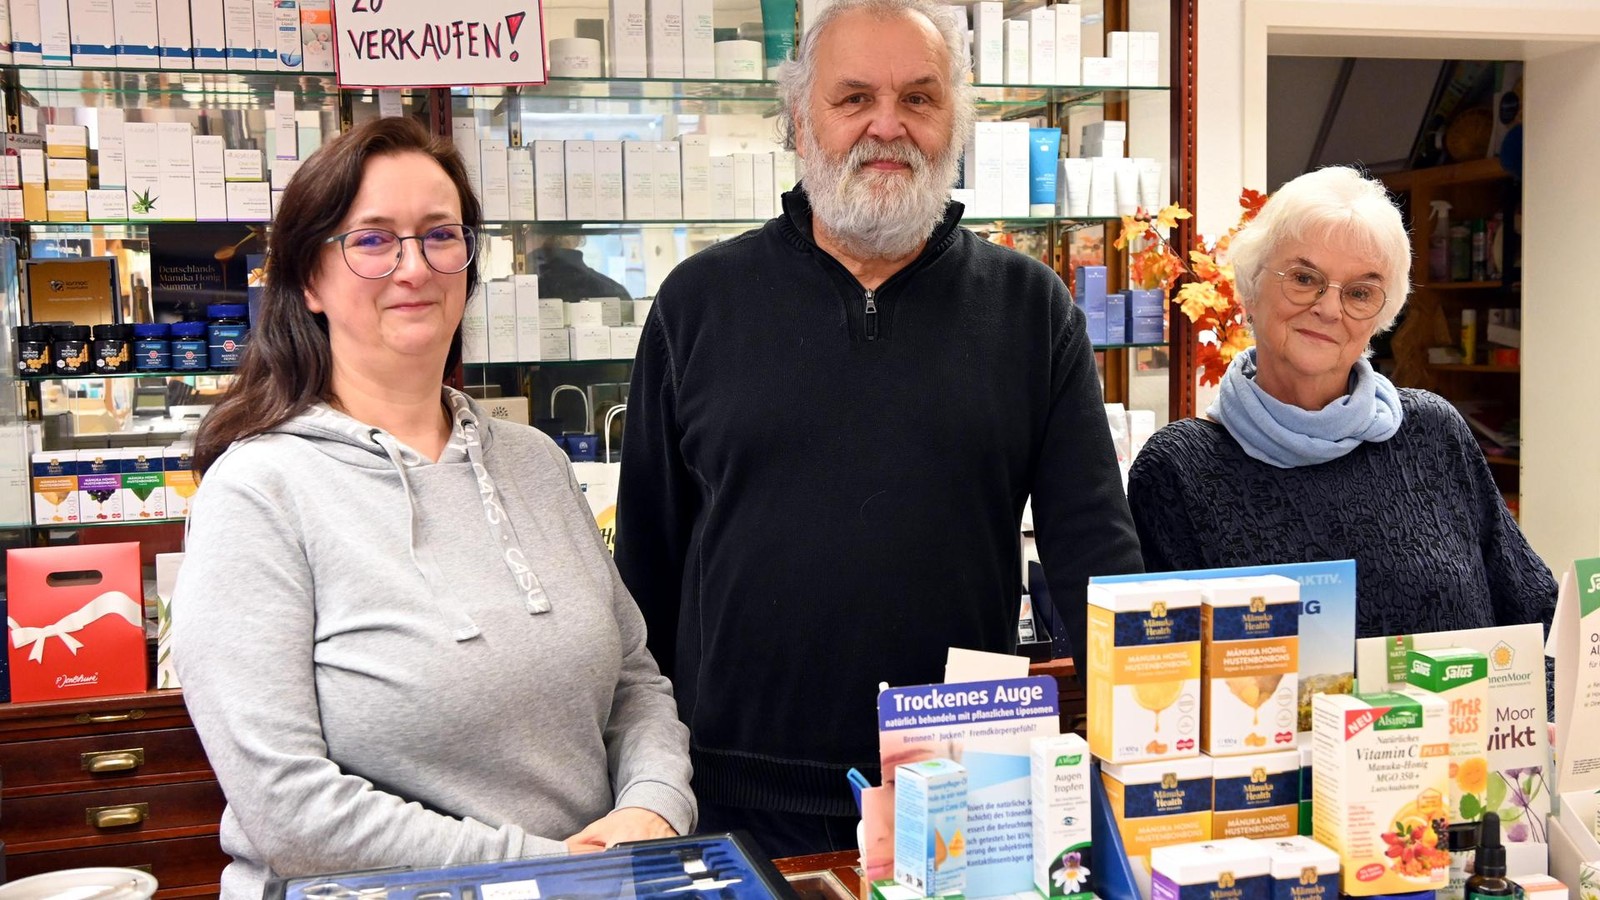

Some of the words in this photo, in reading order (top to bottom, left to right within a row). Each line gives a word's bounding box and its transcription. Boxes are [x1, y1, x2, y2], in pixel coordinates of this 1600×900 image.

[347, 11, 526, 62] VERKAUFEN!
[159, 265, 215, 274] Deutschlands
[195, 274, 221, 283] Honig
[159, 283, 197, 291] Nummer
[1261, 646, 1287, 654] HONIG
[1223, 654, 1290, 665] HUSTENBONBONS
[1442, 664, 1474, 681] Salus
[893, 689, 989, 712] Trockenes
[994, 685, 1043, 706] Auge
[885, 716, 917, 727] natürlich
[919, 713, 956, 725] behandeln
[958, 711, 970, 721] mit
[972, 708, 1014, 722] pflanzlichen
[1016, 705, 1053, 717] Liposomen
[1496, 707, 1535, 723] Moor
[1348, 711, 1373, 734] NEU
[903, 734, 935, 744] Brennen?
[940, 730, 965, 741] Jucken?
[969, 724, 1037, 738] Fremdkörpergefühl?
[1356, 746, 1405, 761] Vitamin
[1408, 744, 1418, 757] C
[1424, 746, 1444, 755] PLUS
[1368, 760, 1428, 772] Manuka-Honig
[1056, 773, 1082, 782] Augen
[1376, 774, 1398, 782] MGO
[1054, 783, 1084, 793] Tropfen
[996, 799, 1025, 808] natürliche
[1261, 814, 1287, 823] HONIG
[1225, 822, 1290, 835] HUSTENBONBONS
